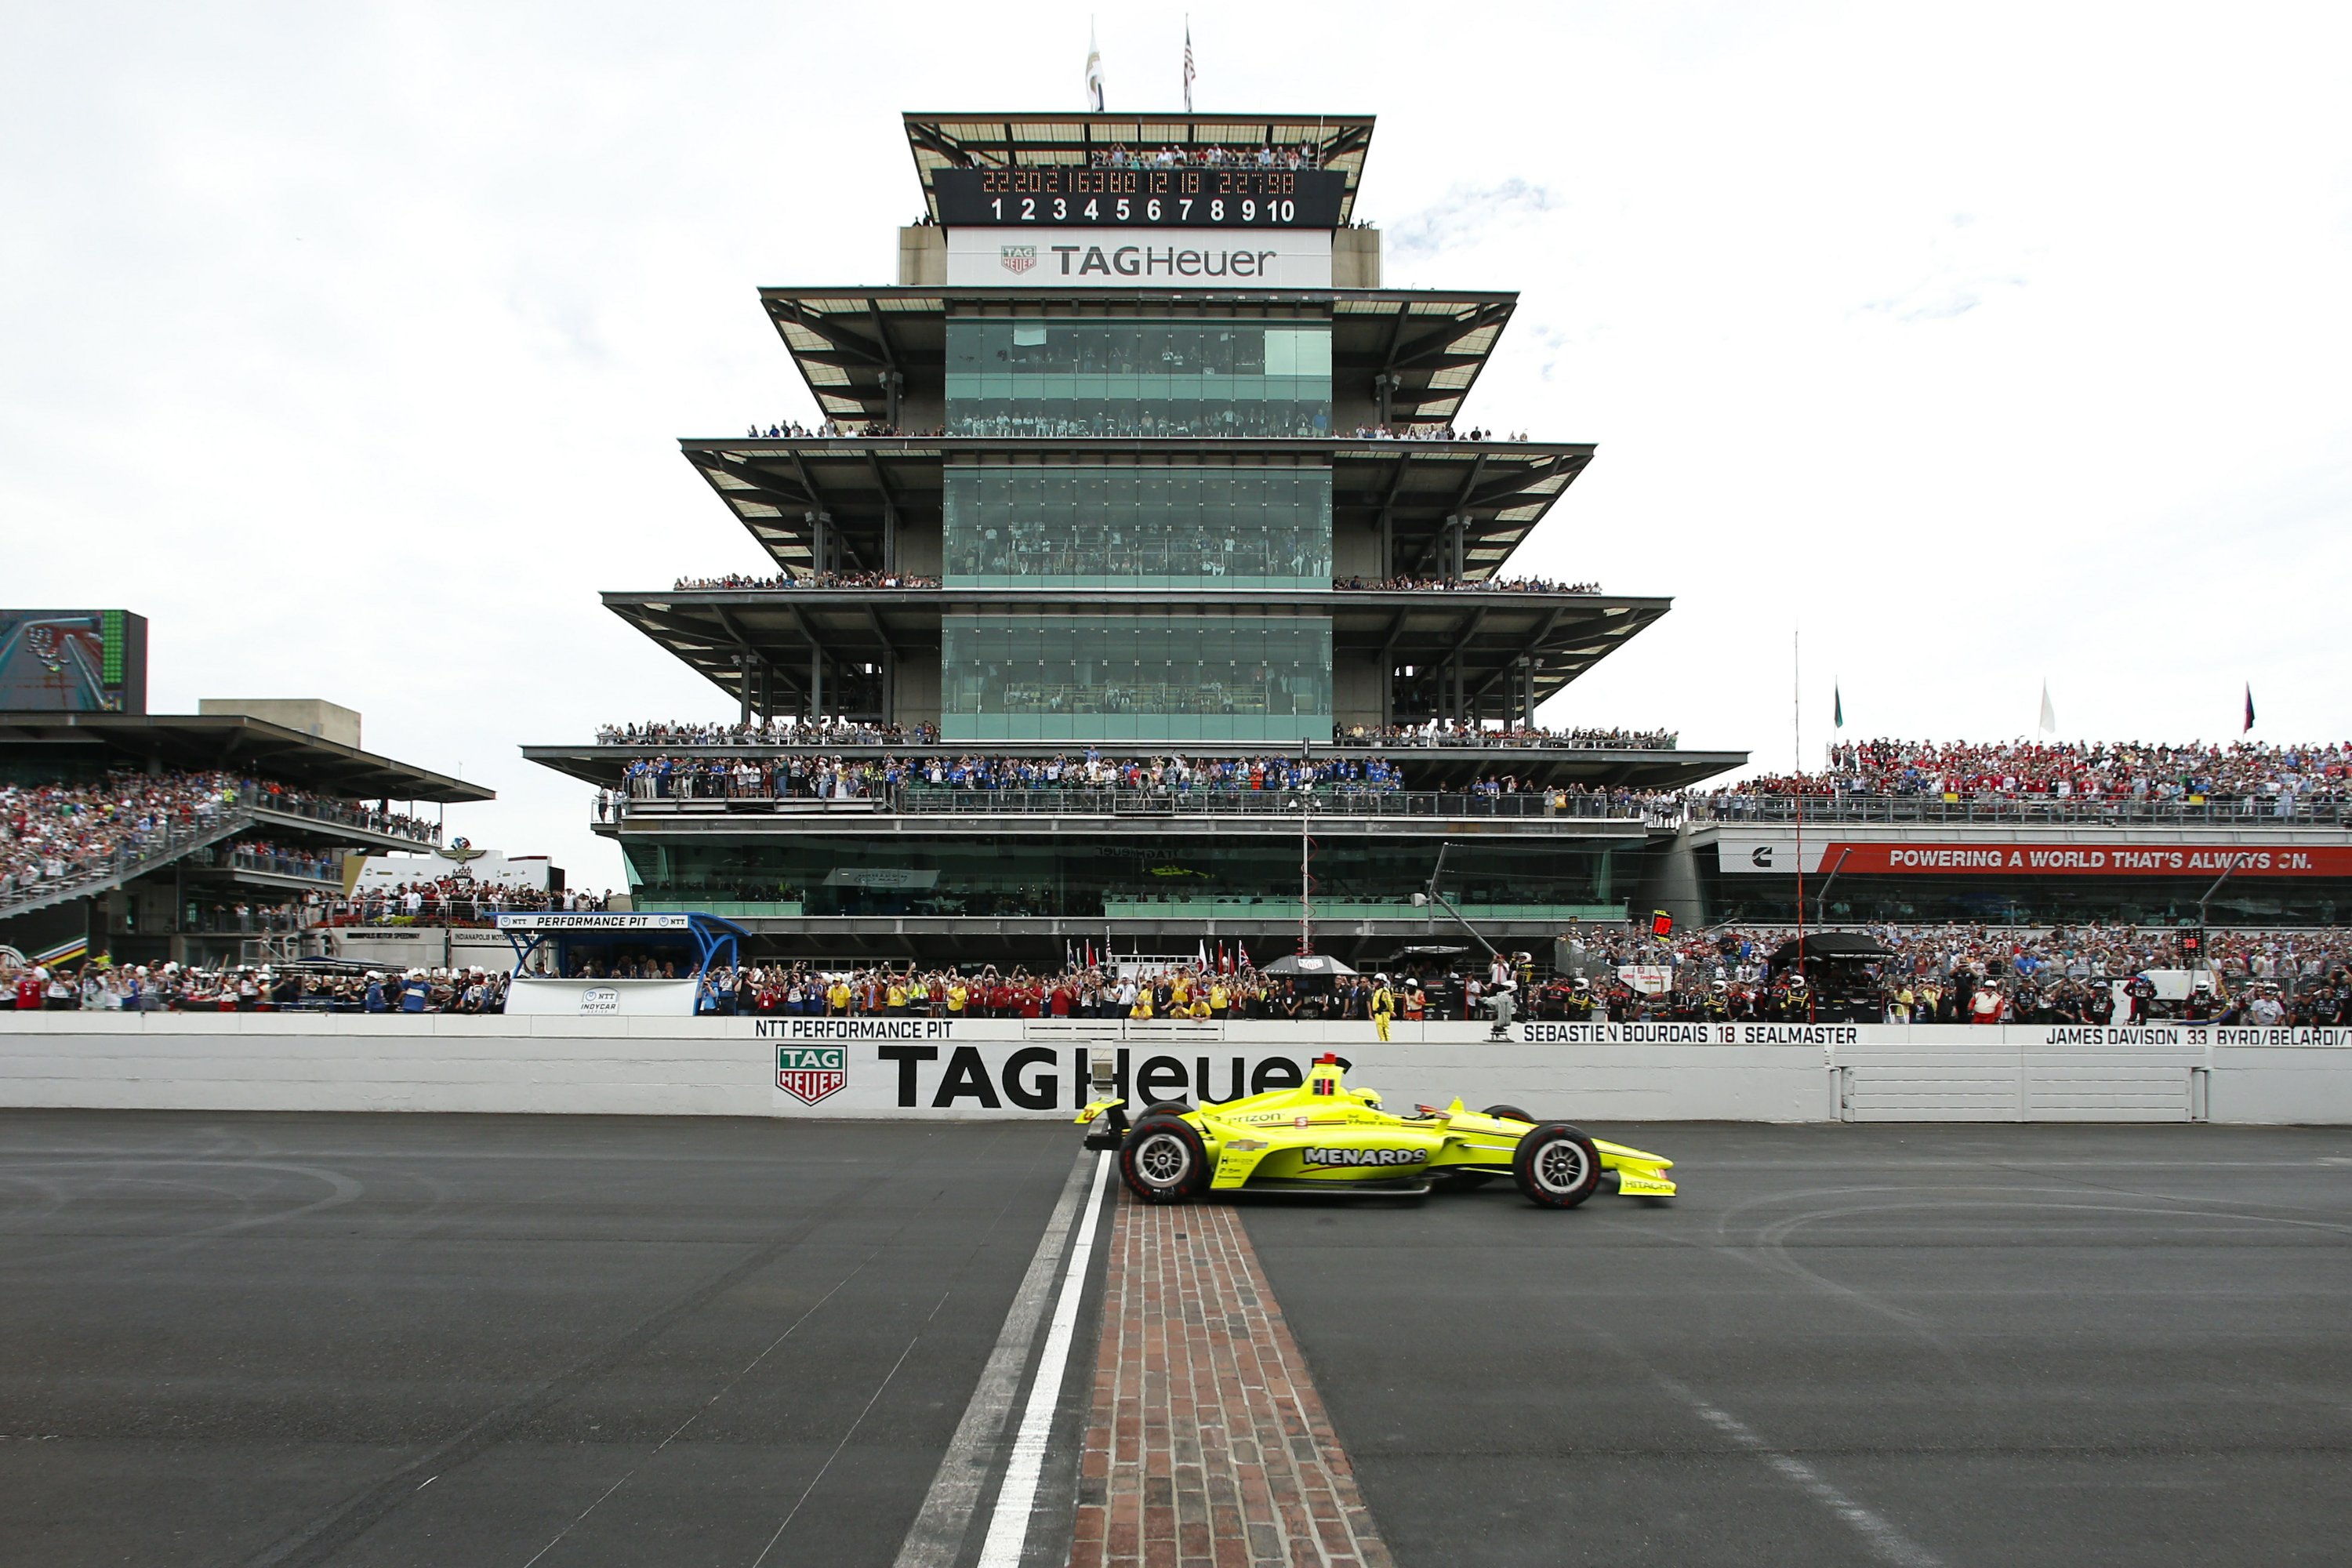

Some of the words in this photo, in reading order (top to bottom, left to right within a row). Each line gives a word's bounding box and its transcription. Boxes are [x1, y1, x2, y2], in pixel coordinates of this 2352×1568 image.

[983, 171, 1009, 193] 22
[1015, 172, 1040, 193] 20
[1047, 172, 1073, 193] 21
[1078, 172, 1104, 194] 63
[1149, 172, 1167, 194] 12
[1181, 172, 1200, 194] 18
[1268, 173, 1294, 194] 98
[991, 198, 1002, 220] 1
[1021, 198, 1036, 220] 2
[1053, 198, 1067, 220] 3
[1084, 198, 1099, 220] 4
[1116, 198, 1130, 220] 5
[1147, 198, 1161, 221] 6
[1179, 199, 1192, 220] 7
[1210, 199, 1225, 221] 8
[1242, 199, 1255, 221] 9
[1267, 200, 1294, 222] 10
[1003, 248, 1033, 257] TAG
[1003, 260, 1034, 270] HEUER
[1889, 850, 2002, 867] POWERING
[2008, 851, 2024, 867] A
[2030, 851, 2105, 868] WORLD
[2111, 852, 2183, 869] THAT'S
[2188, 853, 2270, 869] ALWAYS
[2278, 853, 2312, 869] ON.
[537, 916, 625, 927] PERFORMANCE
[630, 916, 648, 927] PIT
[756, 1020, 788, 1037] NTT
[793, 1021, 922, 1038] PERFORMANCE
[927, 1022, 953, 1038] PIT
[1524, 1025, 1617, 1042] SEBASTIEN
[1623, 1025, 1708, 1043] BOURDAIS
[1718, 1026, 1736, 1043] 18
[1745, 1026, 1857, 1044] SEALMASTER
[2046, 1029, 2103, 1045] JAMES
[2108, 1029, 2178, 1045] DAVISON
[2187, 1029, 2207, 1045] 33
[783, 1051, 839, 1068] TAG
[781, 1073, 841, 1099] HEUER
[1304, 1148, 1428, 1167] MENARDS
[1624, 1180, 1672, 1191] HITACHI
